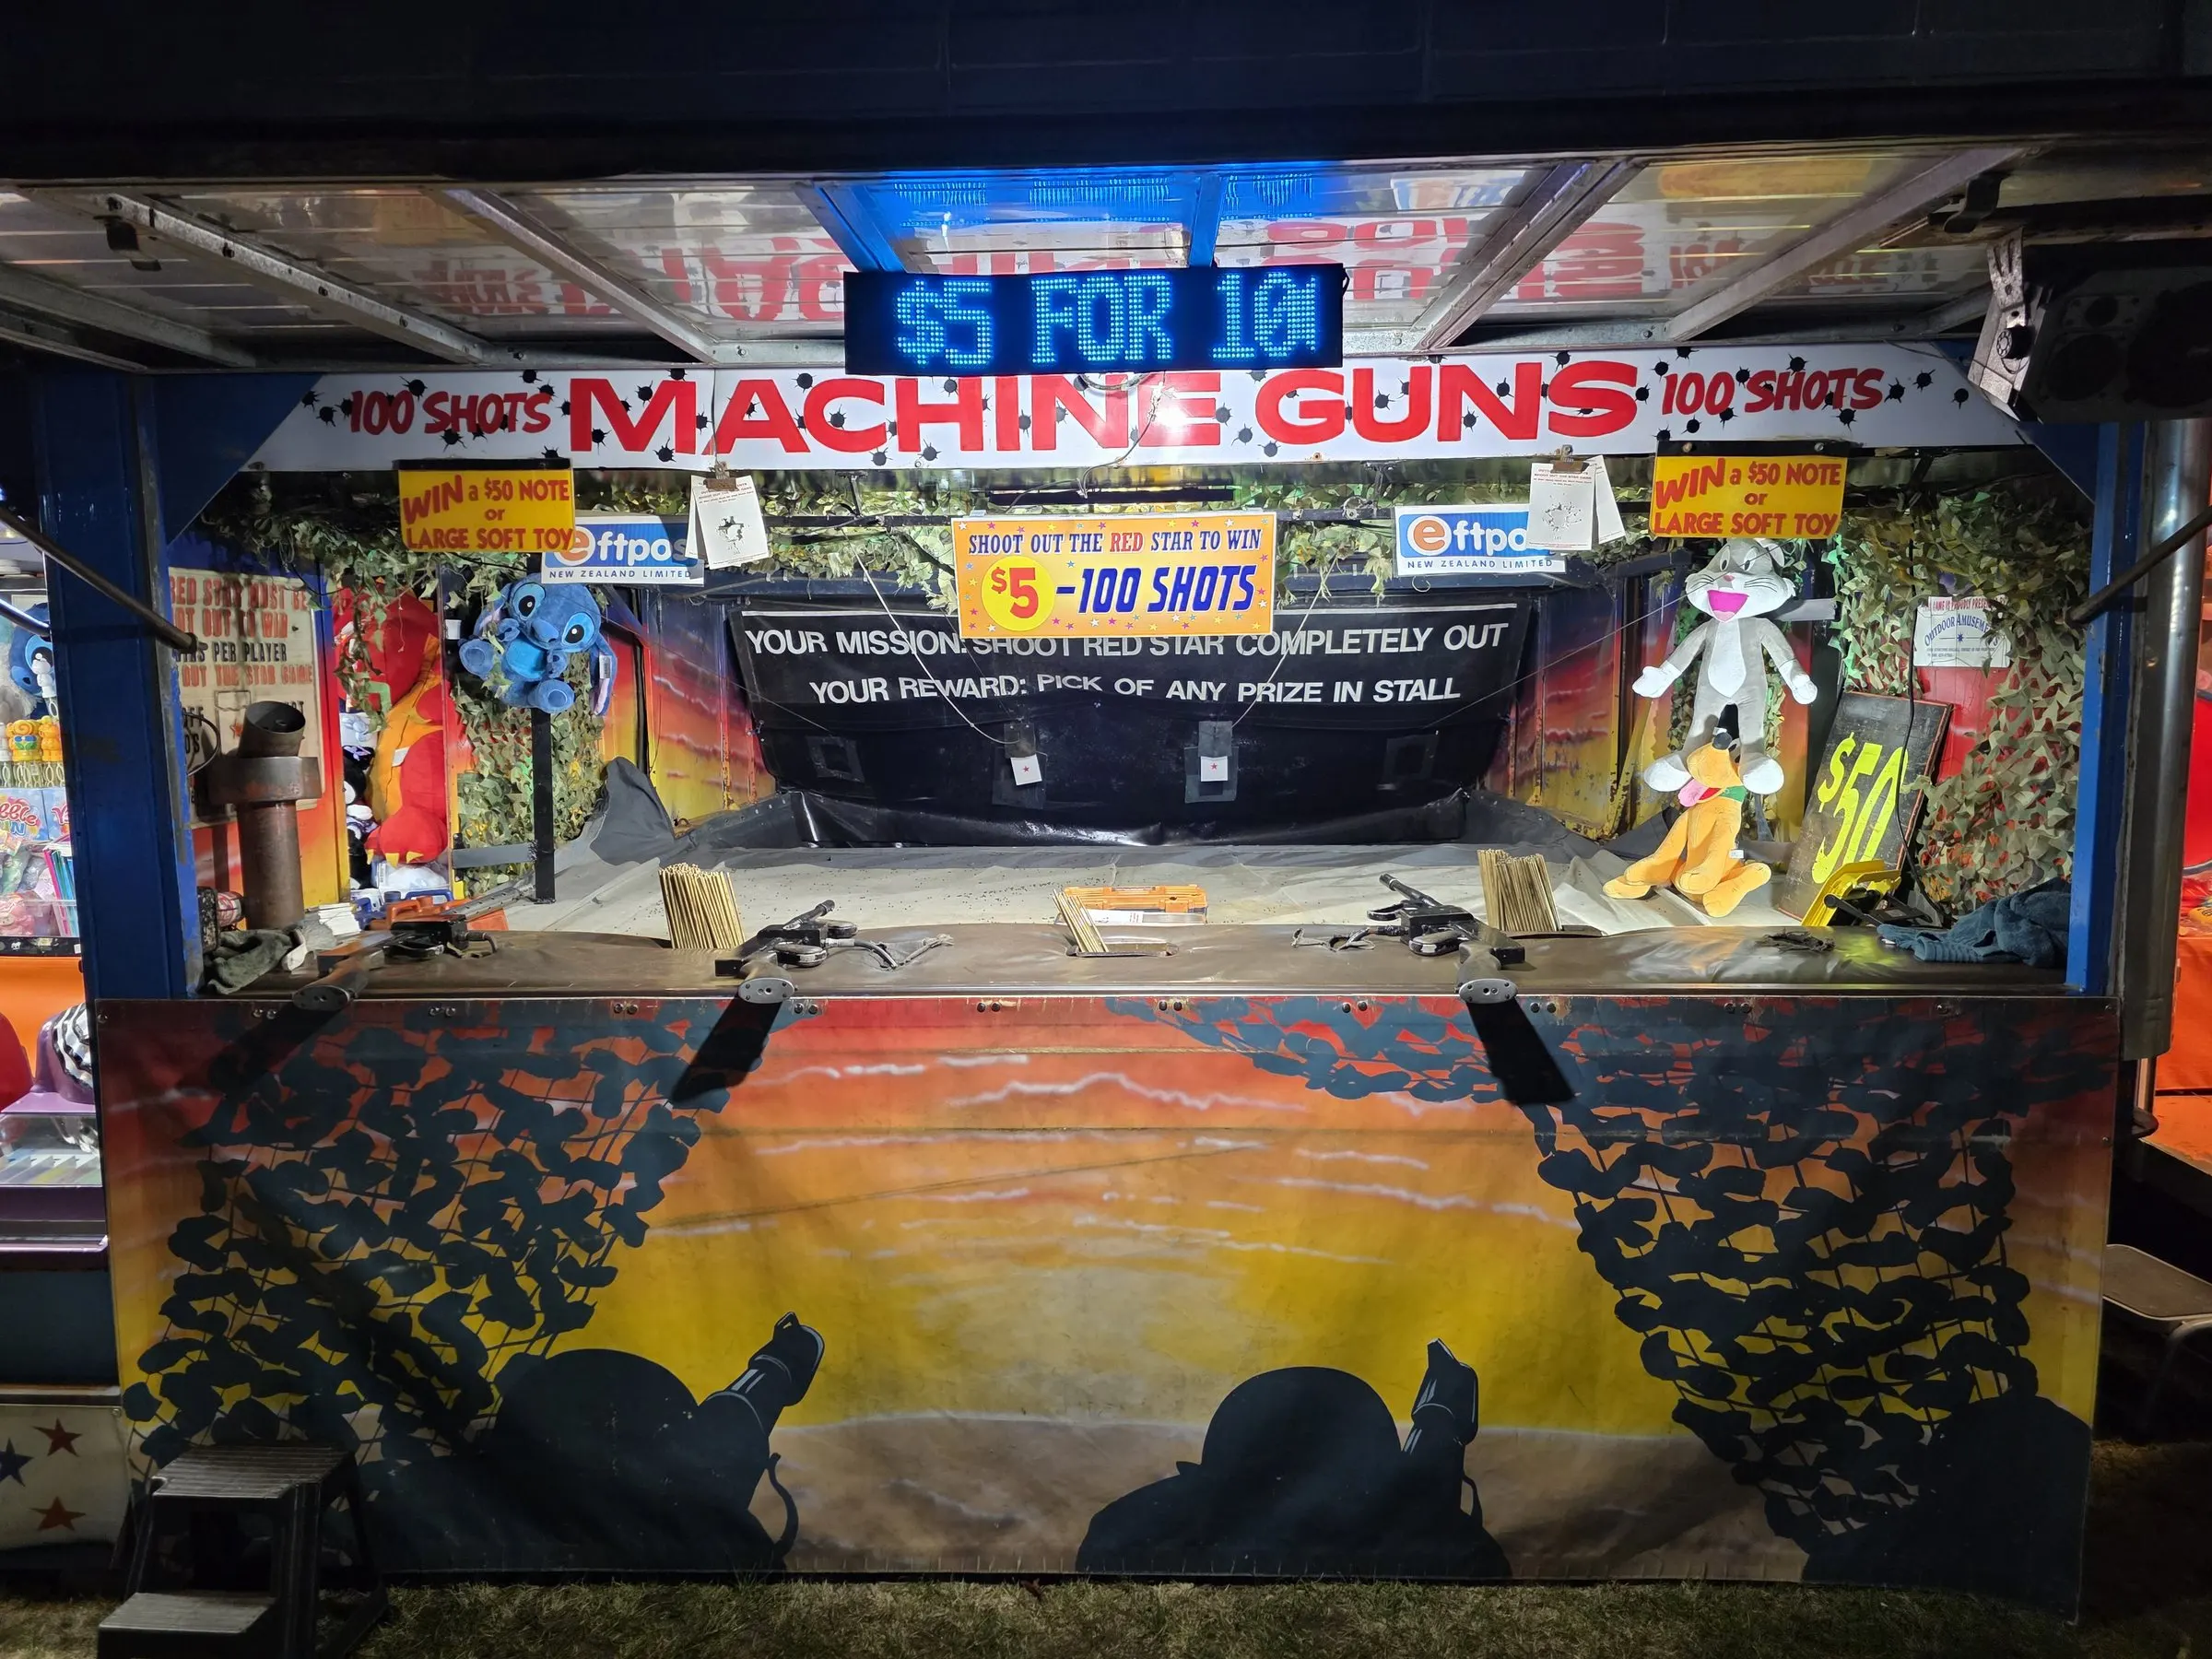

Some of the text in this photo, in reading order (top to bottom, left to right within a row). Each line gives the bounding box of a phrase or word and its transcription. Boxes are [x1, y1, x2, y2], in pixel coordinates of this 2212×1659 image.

[895, 279, 993, 367] $5
[1030, 275, 1172, 365] FOR
[1662, 368, 1885, 416] 100 SHOTS
[349, 389, 552, 436] 100 SHOTS
[571, 359, 1638, 455] MACHINE GUNS
[1655, 457, 1841, 509] WIN a $50 NOTE
[403, 475, 570, 524] WIN a $50 NOTE
[1744, 493, 1769, 505] or
[484, 508, 505, 521] or
[1653, 512, 1839, 536] LARGE SOFT TOY
[406, 527, 573, 551] LARGE SOFT TOY
[969, 528, 1262, 554] SHOOT OUT THE RED STAR TO WIN
[1413, 519, 1527, 556] eftpo
[581, 570, 635, 578] ZEALAND
[642, 570, 691, 578] LIMITED
[1407, 559, 1553, 569] NEW ZEALAND LIMITED
[248, 582, 285, 610] MUST
[991, 566, 1040, 619] $5
[1147, 565, 1258, 613] SHOTS
[203, 608, 231, 638] OUT
[262, 611, 288, 638] WIN
[212, 641, 237, 662] PER
[243, 641, 288, 662] PLAYER
[745, 623, 1509, 656] YOUR MISSION: SHOOT RED STAR COMPLETELY OUT
[181, 664, 313, 687] OUT THE STAR GAME
[809, 674, 1461, 703] YOUR REWARD: PICK OF ANY PRIZE IN STALL
[1812, 732, 1909, 884] $50
